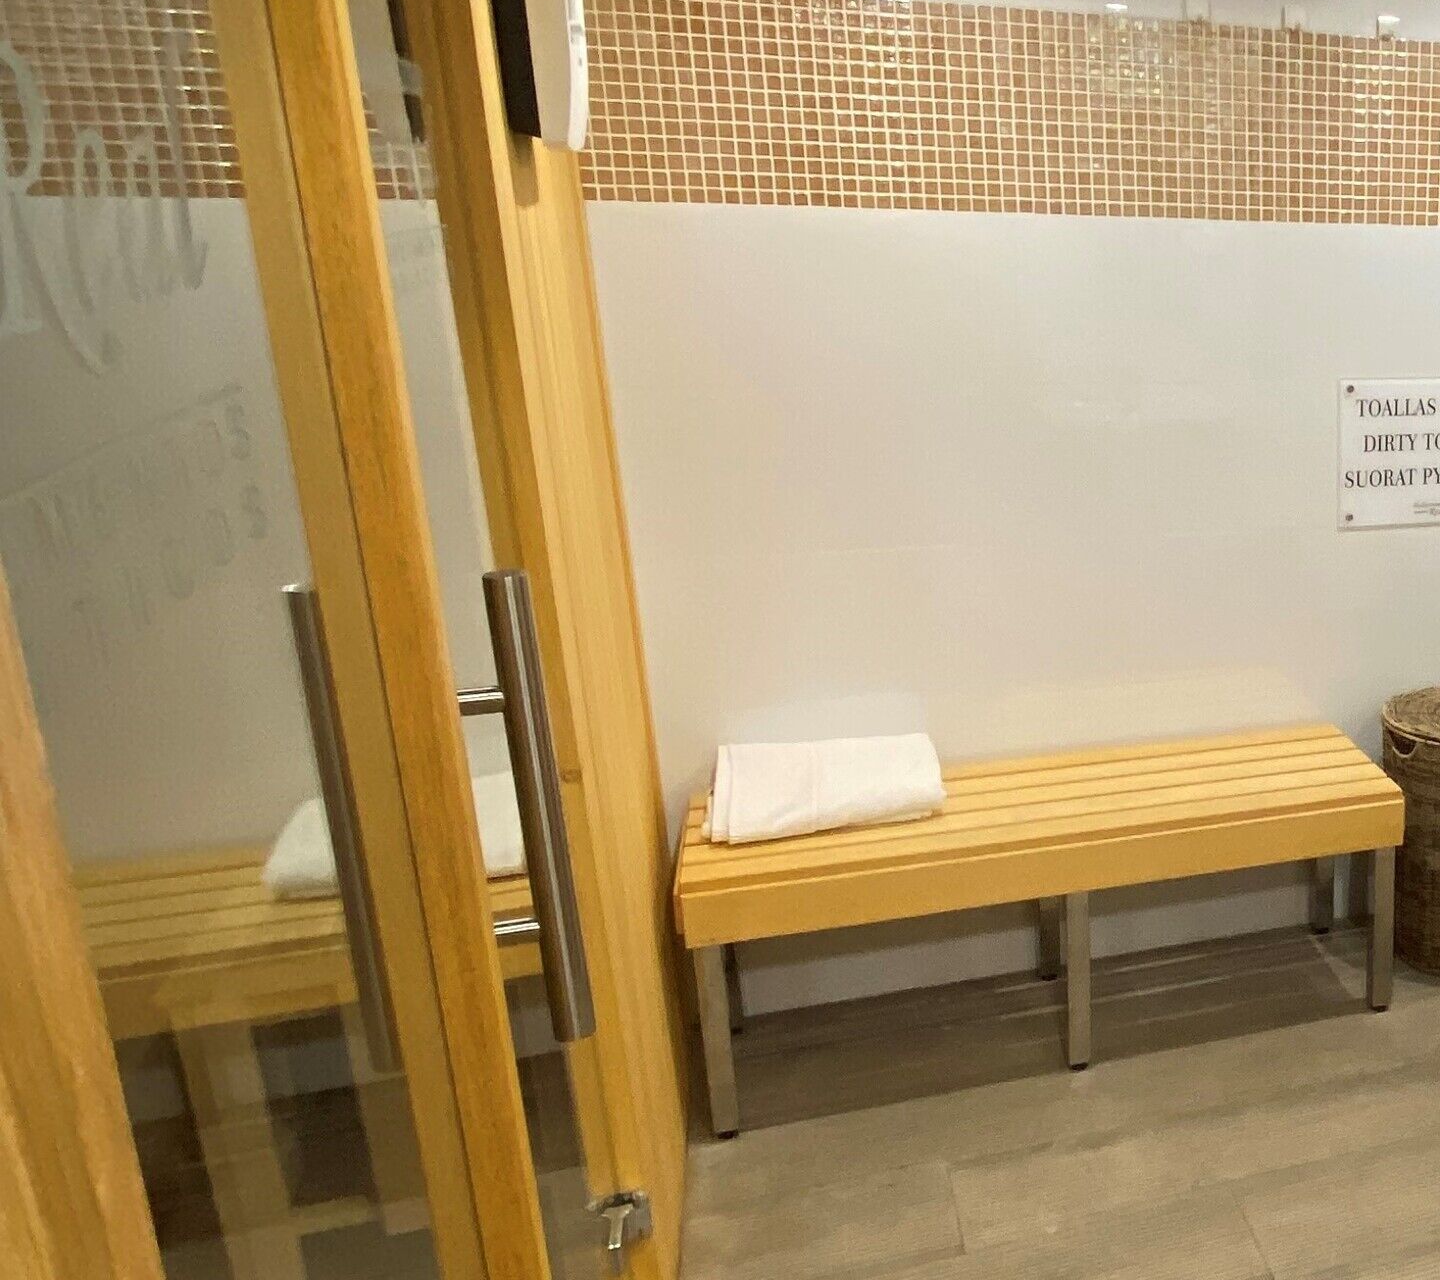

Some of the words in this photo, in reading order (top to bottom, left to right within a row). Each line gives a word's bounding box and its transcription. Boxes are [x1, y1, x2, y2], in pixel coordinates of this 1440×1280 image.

[1355, 398, 1437, 418] TOALLAS
[1363, 433, 1418, 453] DIRTY
[1344, 468, 1420, 489] SUORAT
